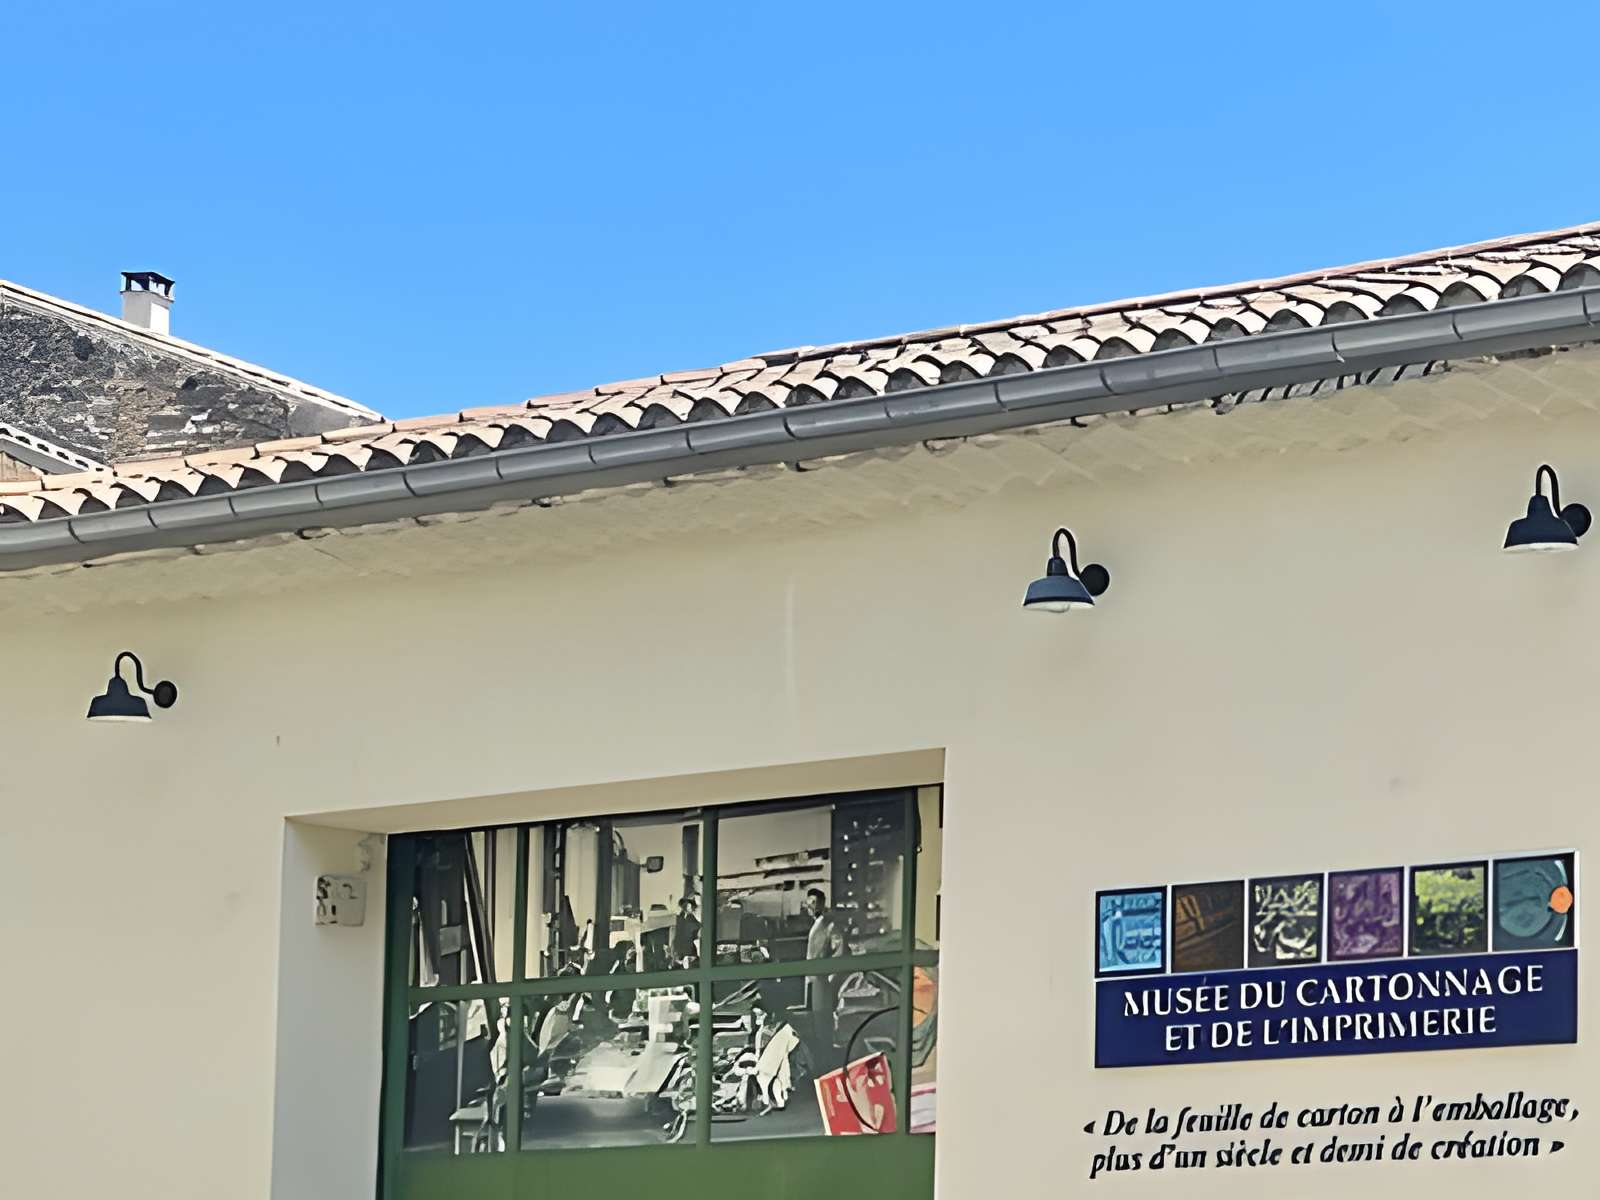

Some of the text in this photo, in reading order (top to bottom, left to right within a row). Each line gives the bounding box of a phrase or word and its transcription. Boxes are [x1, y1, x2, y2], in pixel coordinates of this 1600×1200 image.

[1124, 965, 1543, 1016] MUSÉE DU CARTONNAGE
[1165, 1006, 1496, 1050] ET DE L'IMPRIMERIE
[1103, 1110, 1139, 1136] De
[1145, 1108, 1169, 1134] la
[1171, 1103, 1253, 1139] feuille
[1260, 1102, 1290, 1128] de
[1297, 1104, 1380, 1128] carton
[1388, 1096, 1405, 1123] à
[1089, 1145, 1143, 1179] plus
[1149, 1143, 1207, 1170] d'un
[1291, 1143, 1315, 1164] et
[1319, 1134, 1385, 1163] demi
[1391, 1133, 1423, 1160] de
[1431, 1130, 1540, 1159] création
